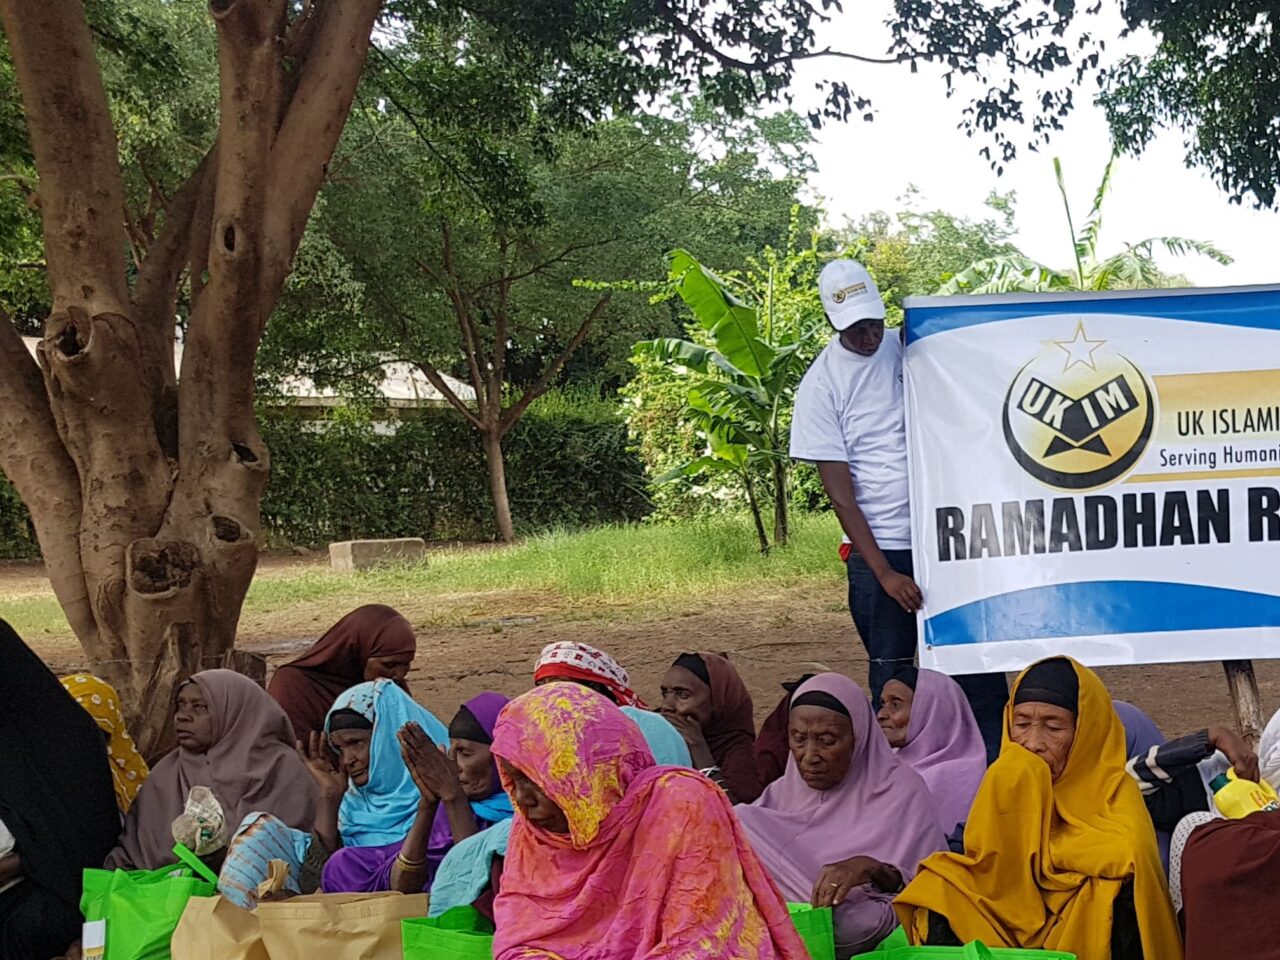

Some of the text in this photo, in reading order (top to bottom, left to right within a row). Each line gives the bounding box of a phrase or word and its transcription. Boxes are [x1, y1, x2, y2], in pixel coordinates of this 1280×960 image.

[1177, 410, 1206, 436] UK
[1160, 446, 1217, 469] Serving
[935, 488, 1231, 562] RAMADHAN
